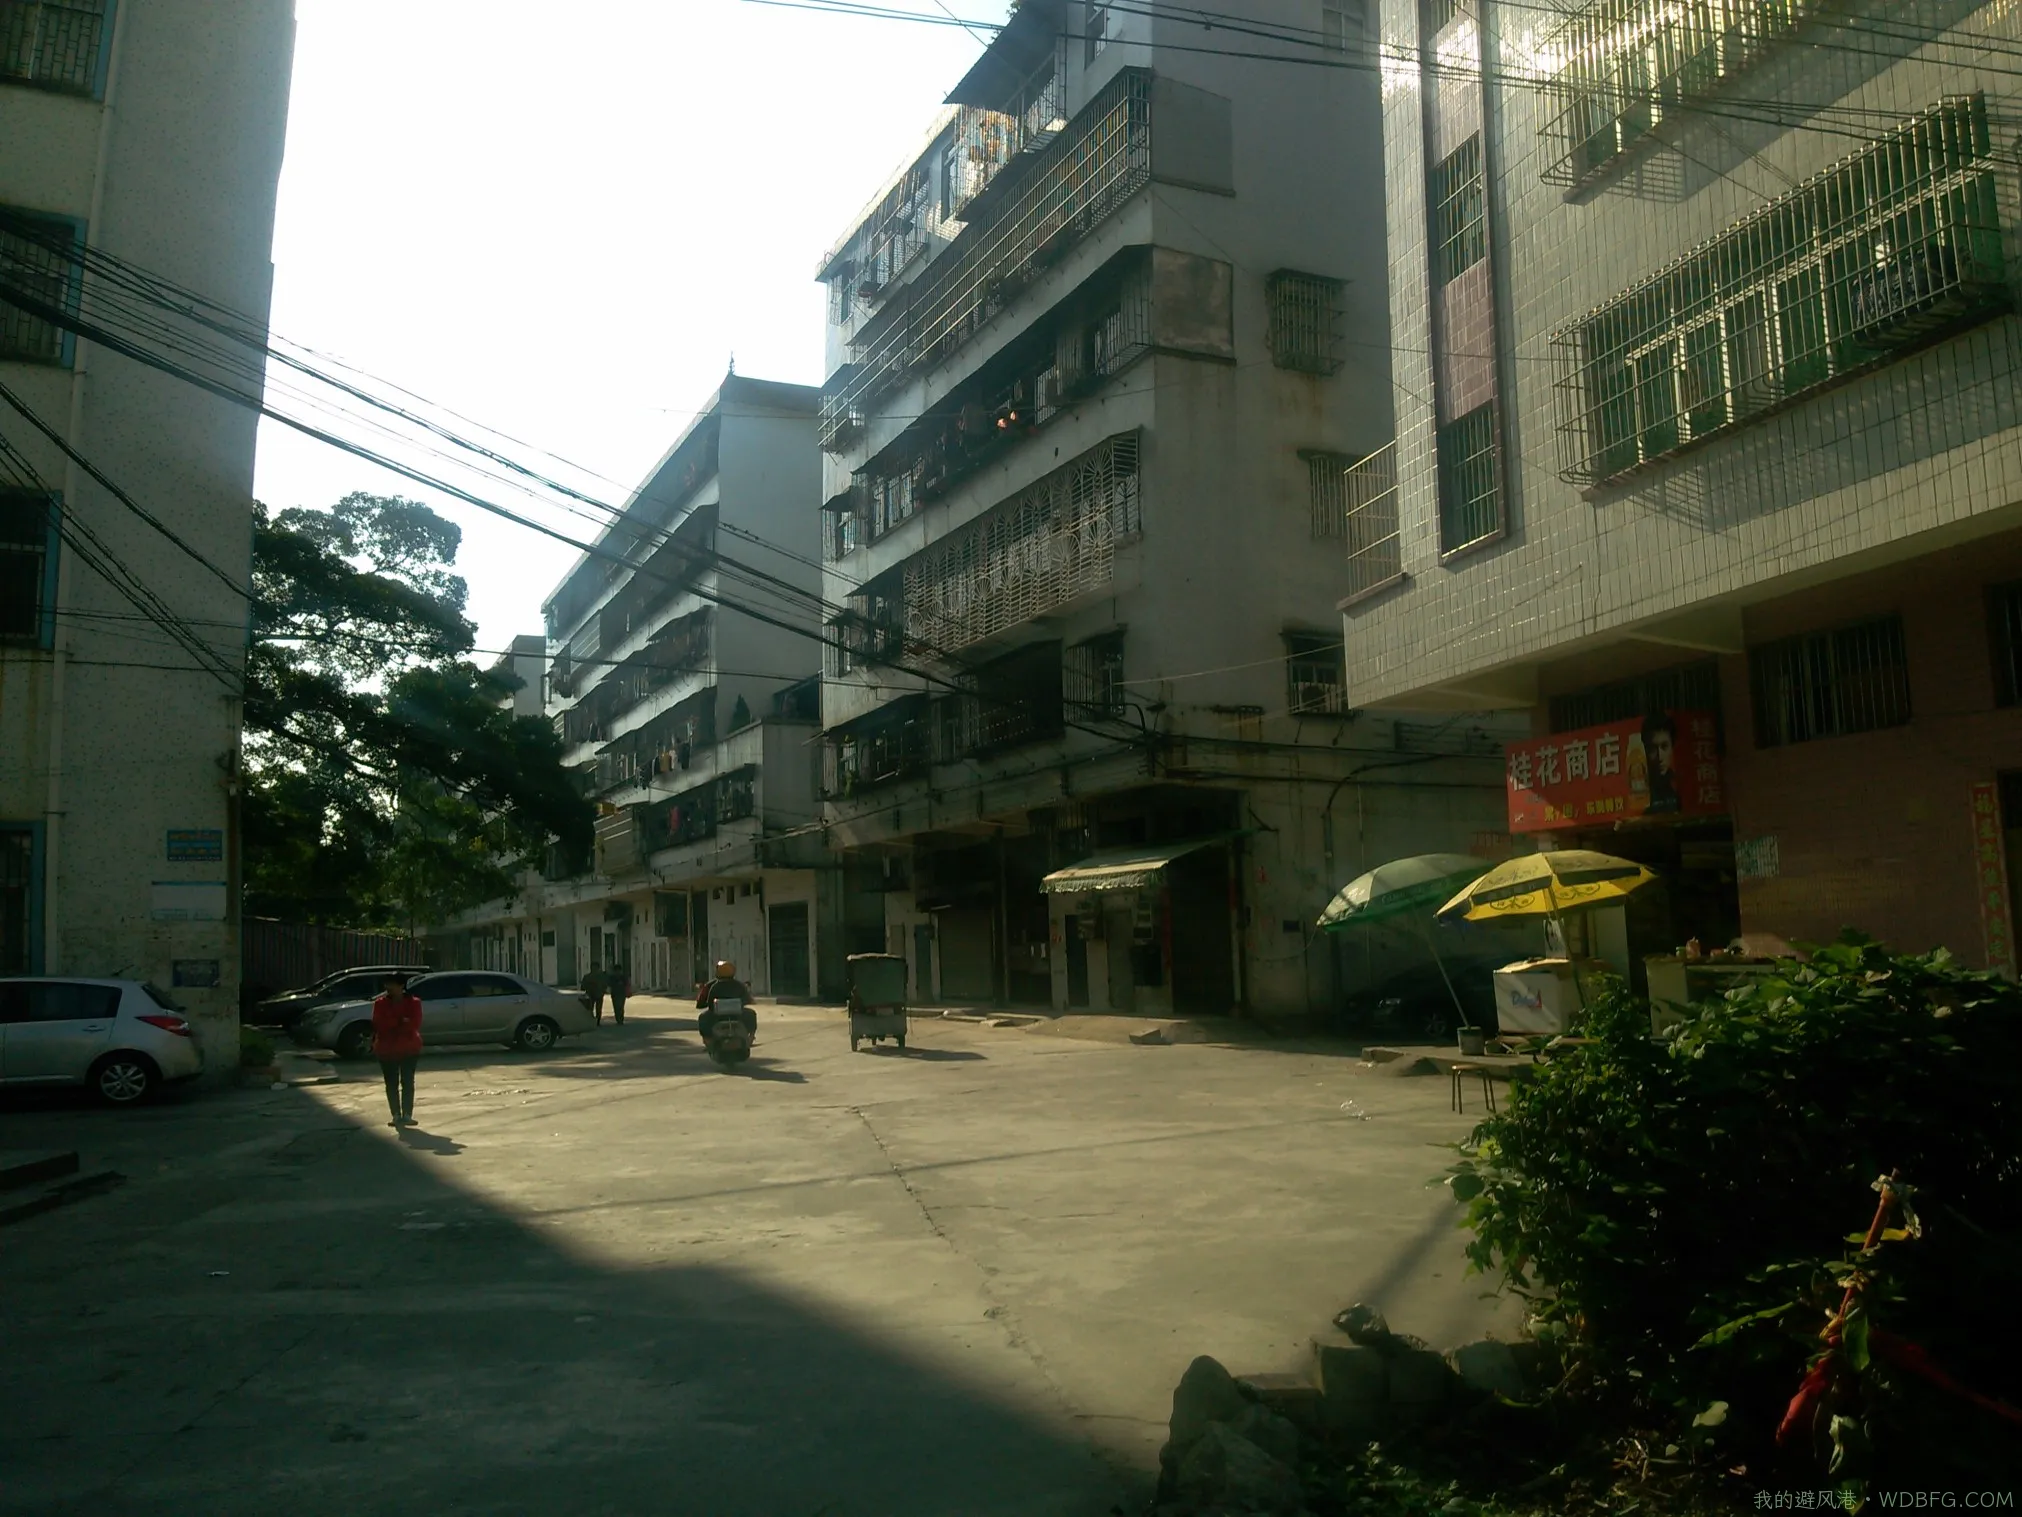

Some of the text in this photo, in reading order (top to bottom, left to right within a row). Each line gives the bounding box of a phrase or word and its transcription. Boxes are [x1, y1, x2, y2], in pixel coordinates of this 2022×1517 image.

[1509, 732, 1620, 791] 桂花商店
[1689, 717, 1722, 805] 桂花商店
